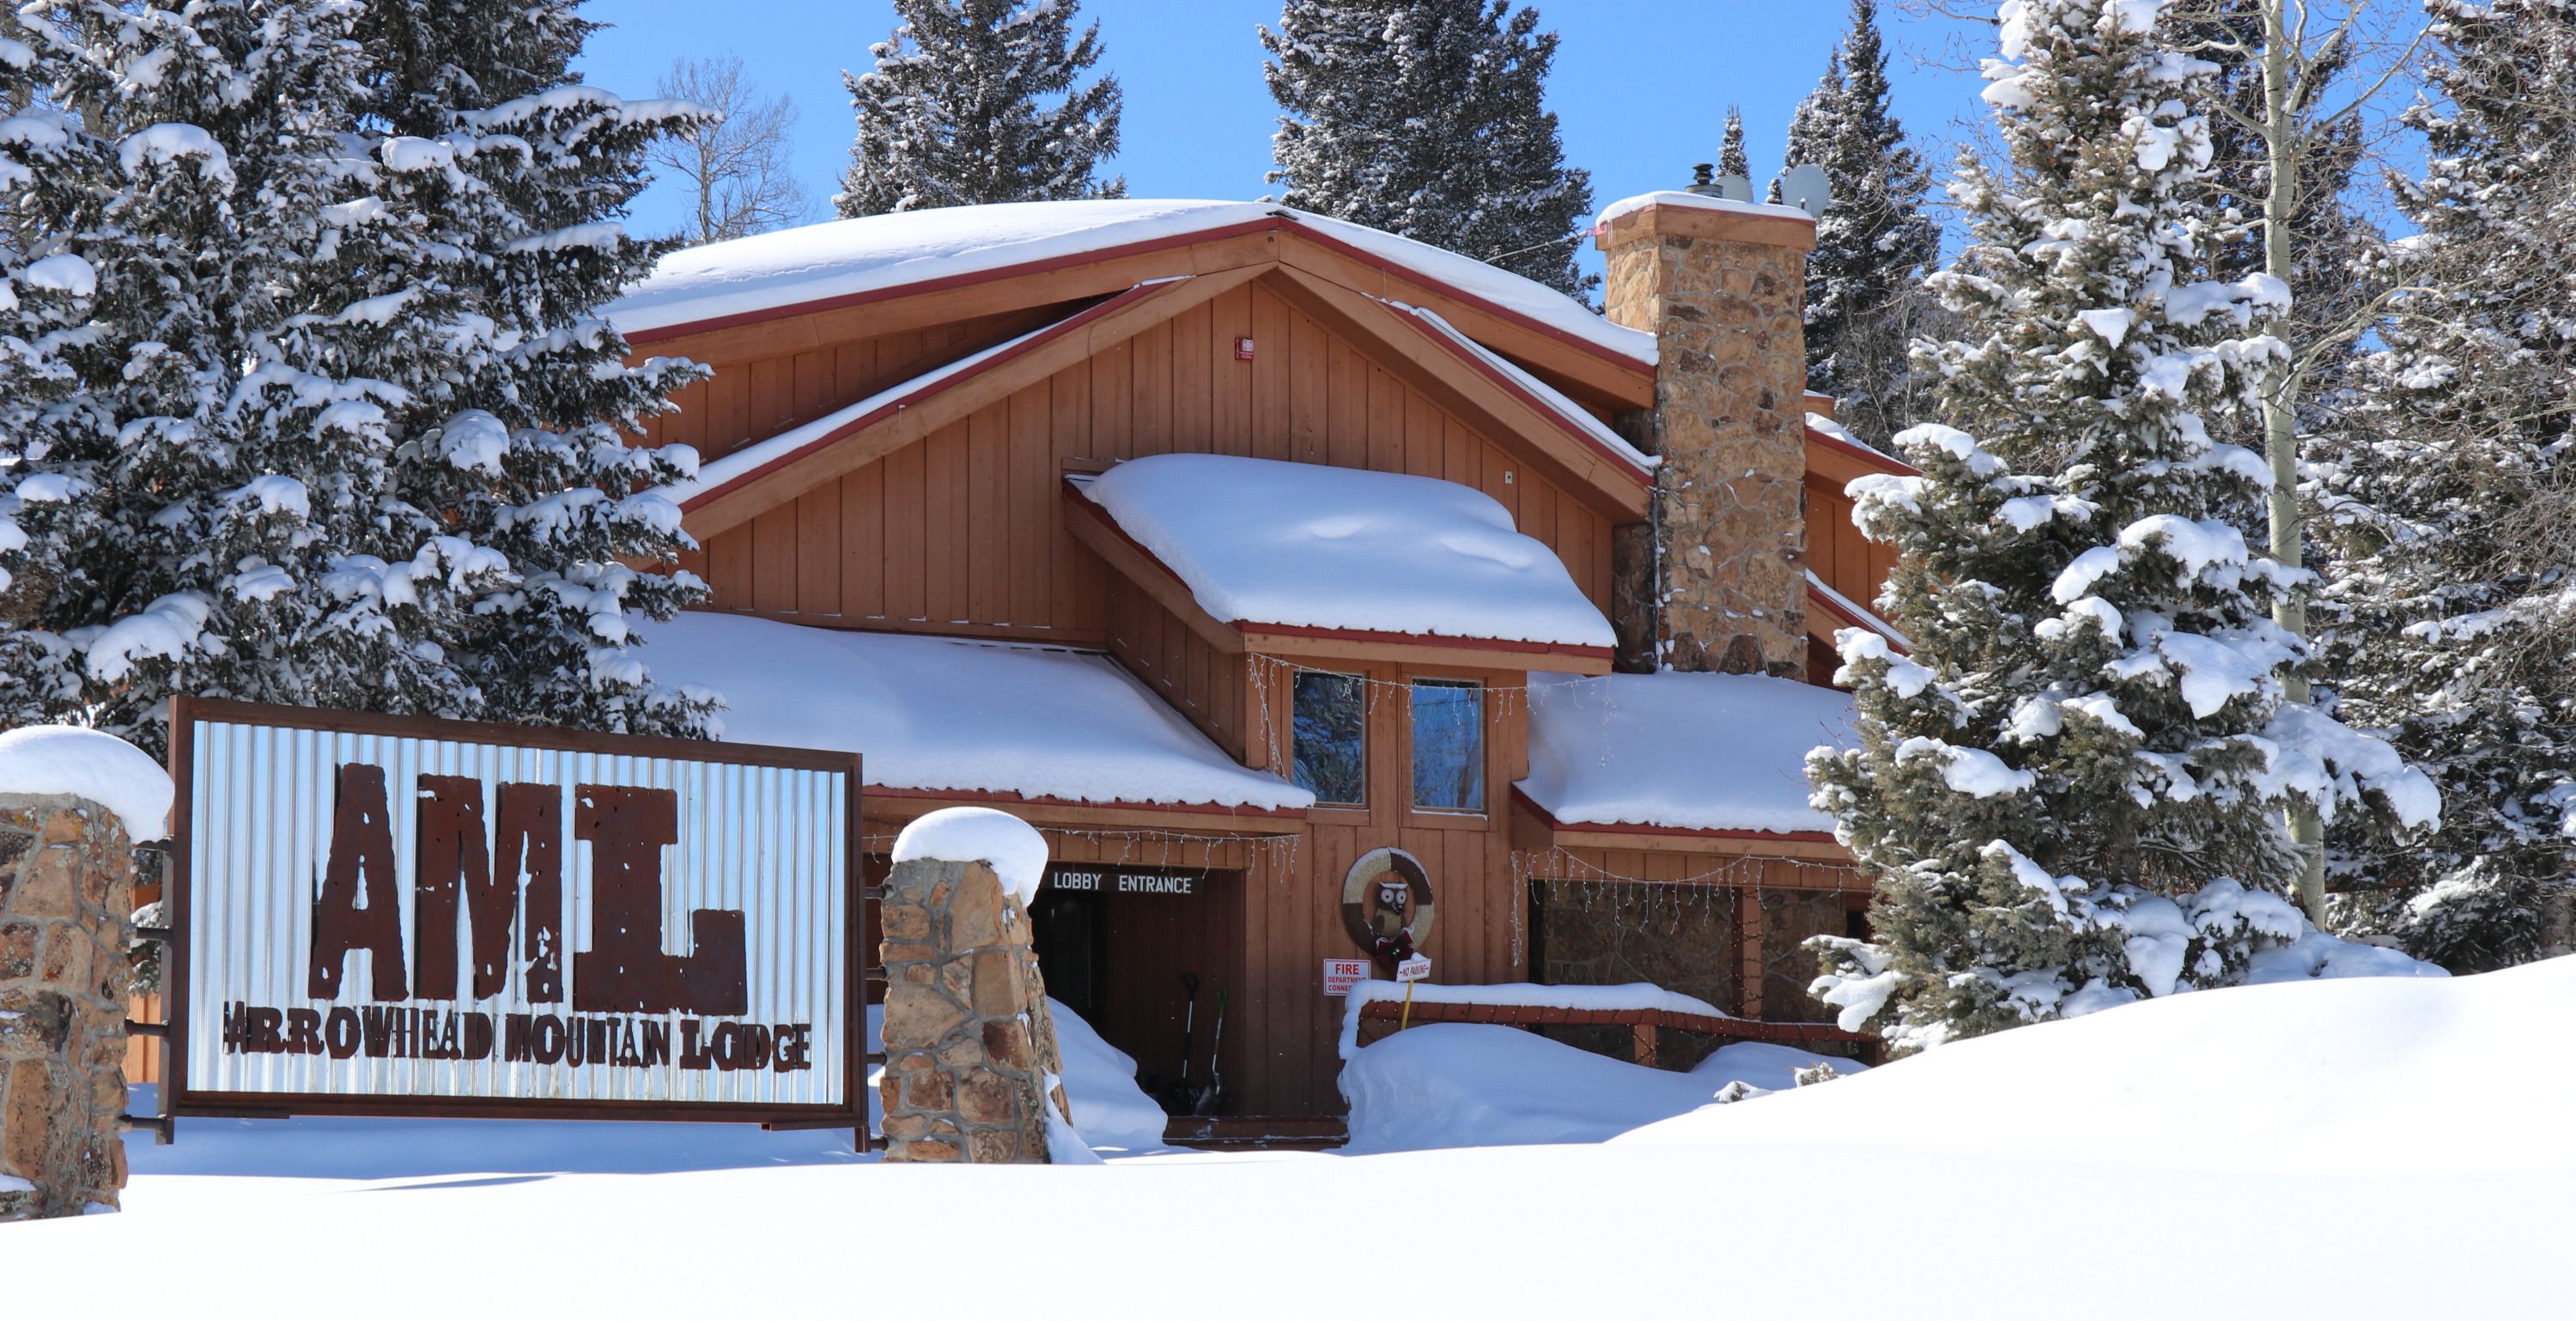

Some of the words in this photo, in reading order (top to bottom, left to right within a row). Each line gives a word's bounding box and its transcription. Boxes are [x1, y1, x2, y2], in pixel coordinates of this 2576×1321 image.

[307, 762, 748, 1016] AML
[1054, 872, 1103, 891] LOBBY
[1118, 874, 1193, 894] ENTRANCE
[1335, 963, 1359, 975] FIRE
[1402, 966, 1410, 977] NO
[1410, 964, 1427, 977] PARKING
[223, 1001, 494, 1060] ARROWHEAD
[504, 1013, 671, 1068] MOUNTAIN
[679, 1018, 812, 1073] LODGE
